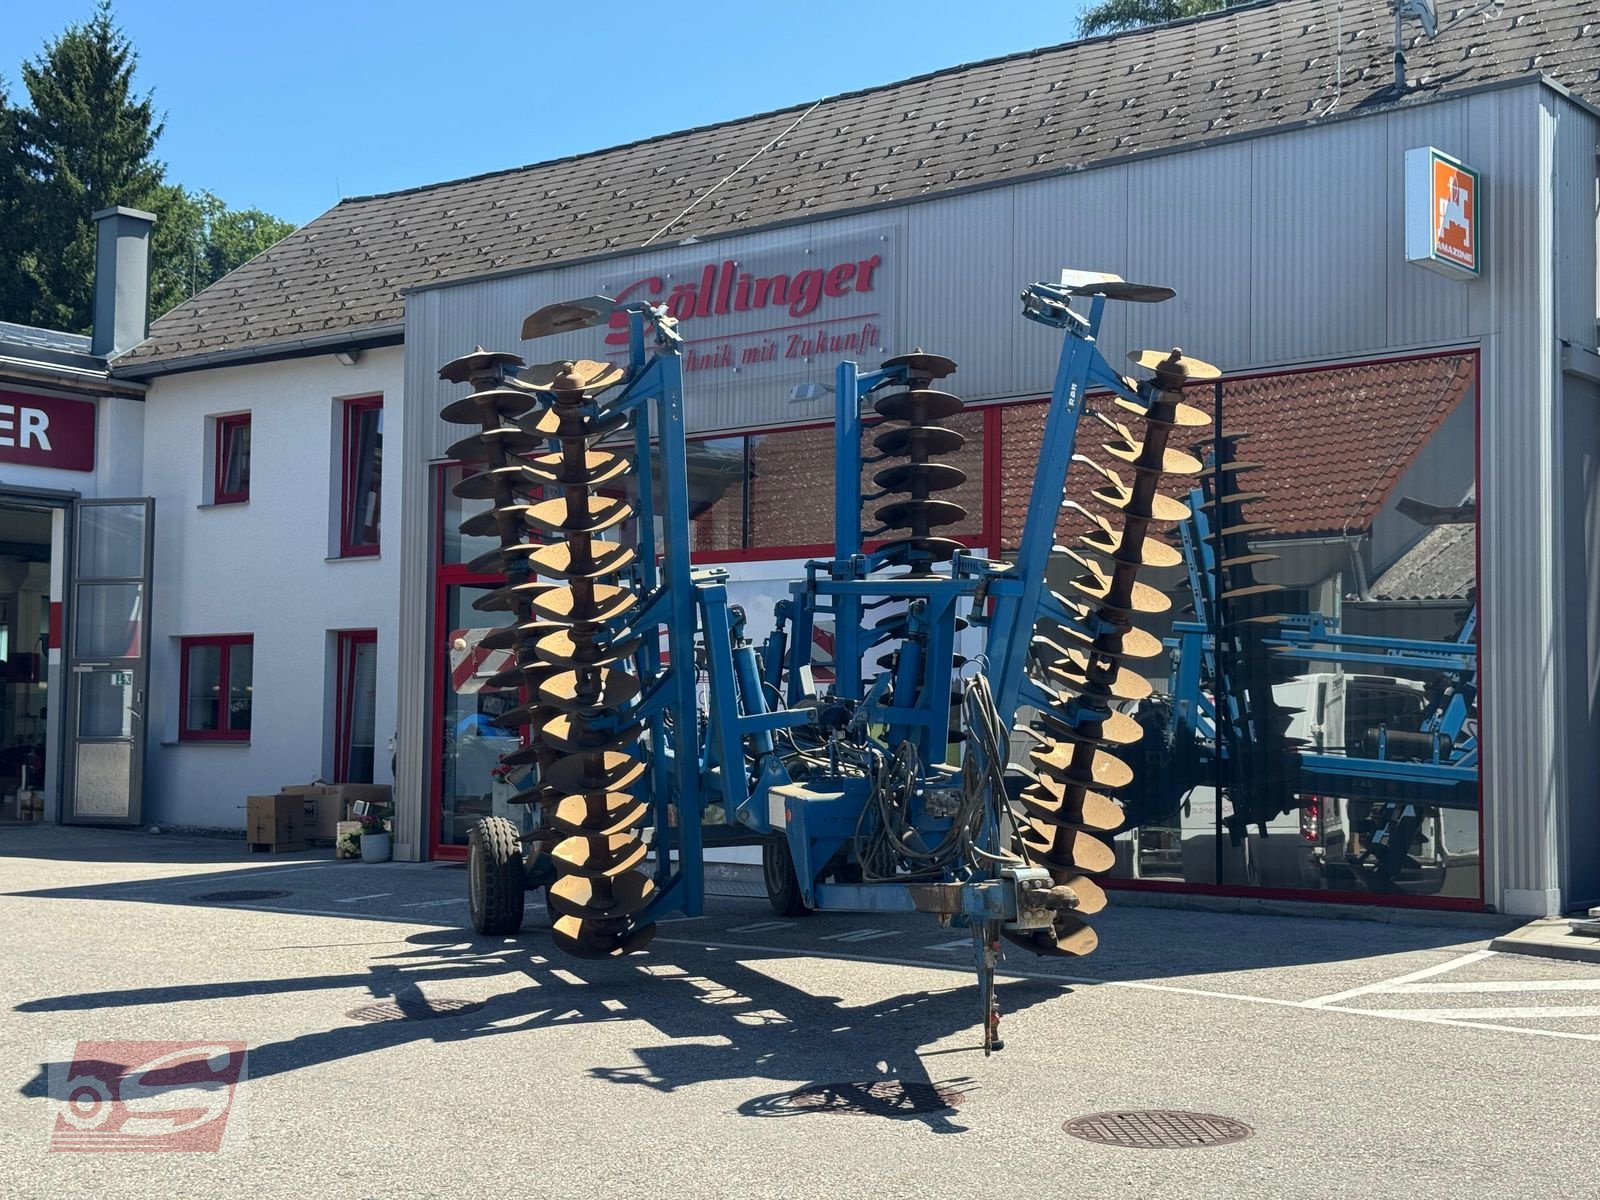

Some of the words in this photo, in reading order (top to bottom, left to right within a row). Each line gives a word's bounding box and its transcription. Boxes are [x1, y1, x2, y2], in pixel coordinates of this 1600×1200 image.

[1437, 242, 1472, 262] AMAZONE
[741, 338, 777, 364] mit
[785, 322, 879, 359] Zukunft
